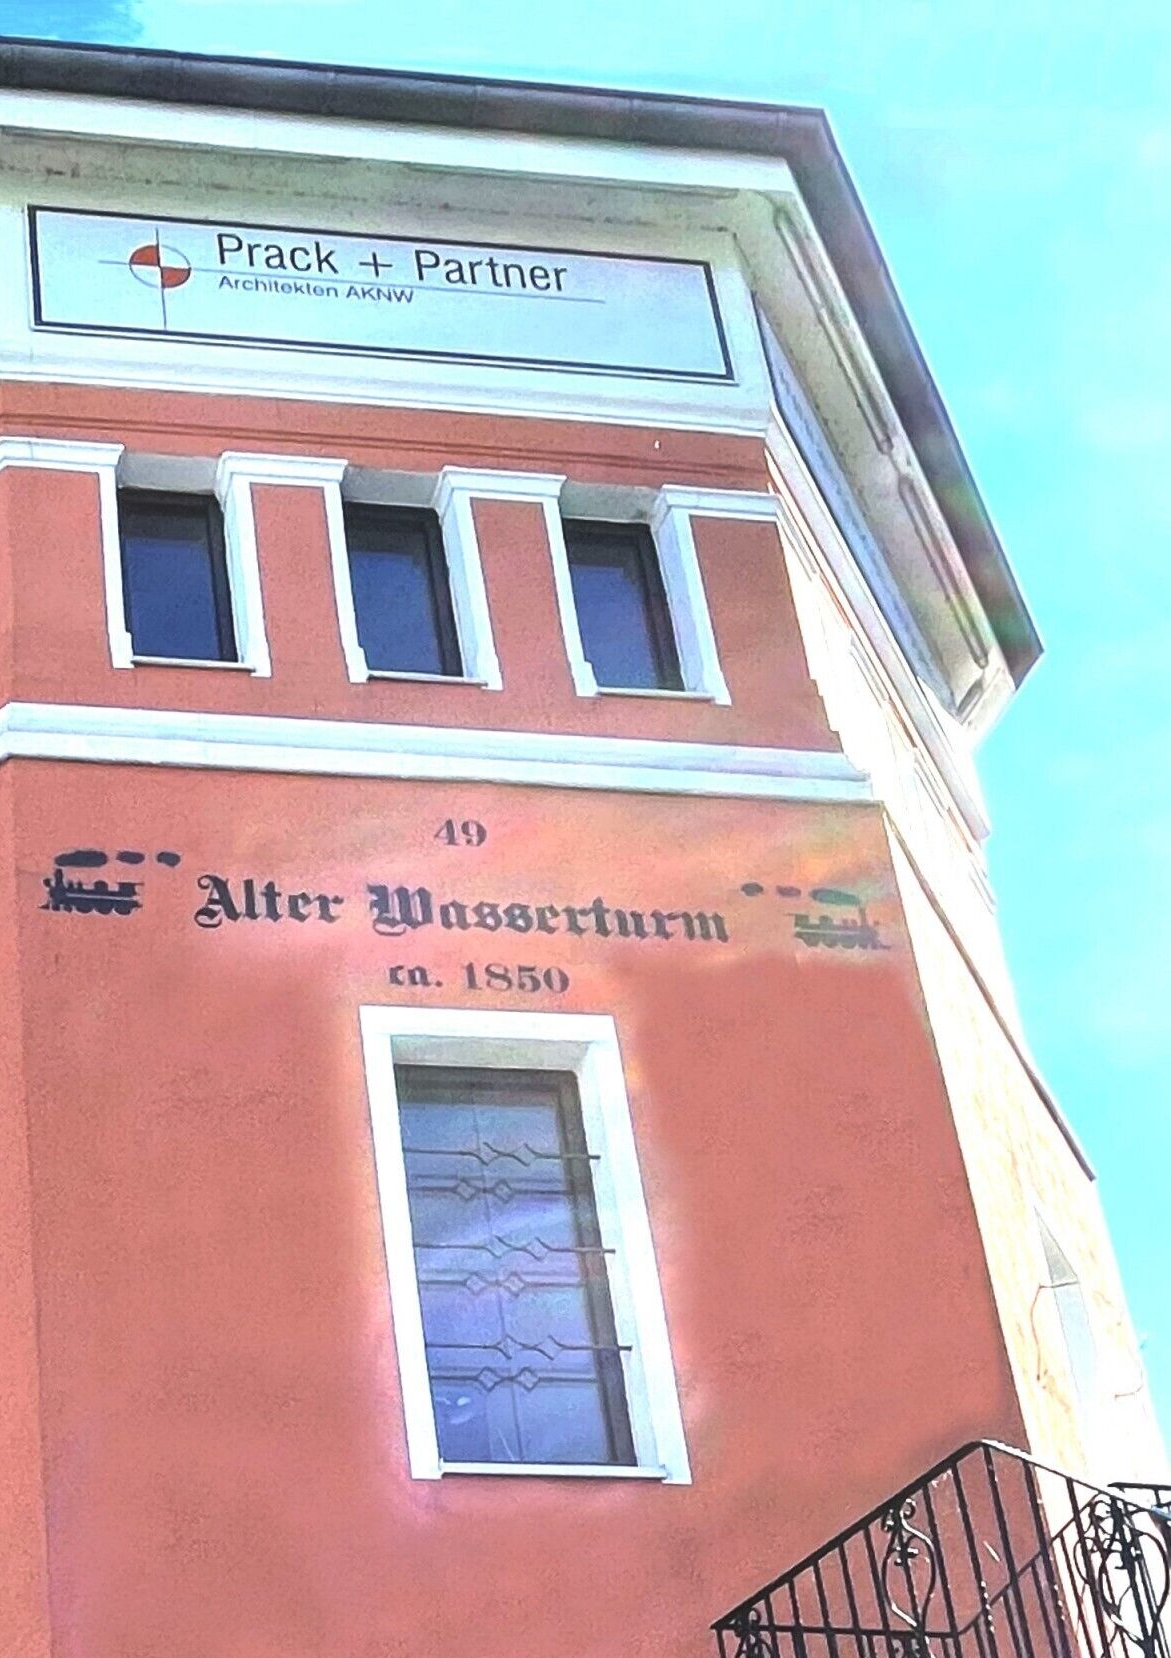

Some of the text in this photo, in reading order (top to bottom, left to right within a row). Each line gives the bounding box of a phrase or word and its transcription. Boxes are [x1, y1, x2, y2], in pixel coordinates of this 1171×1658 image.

[216, 233, 568, 292] Prack + Partner
[218, 276, 414, 304] Architekten AKNW
[434, 819, 487, 847] 49
[195, 875, 730, 943] Alter Wasserturm
[390, 962, 570, 994] ca. 1850
